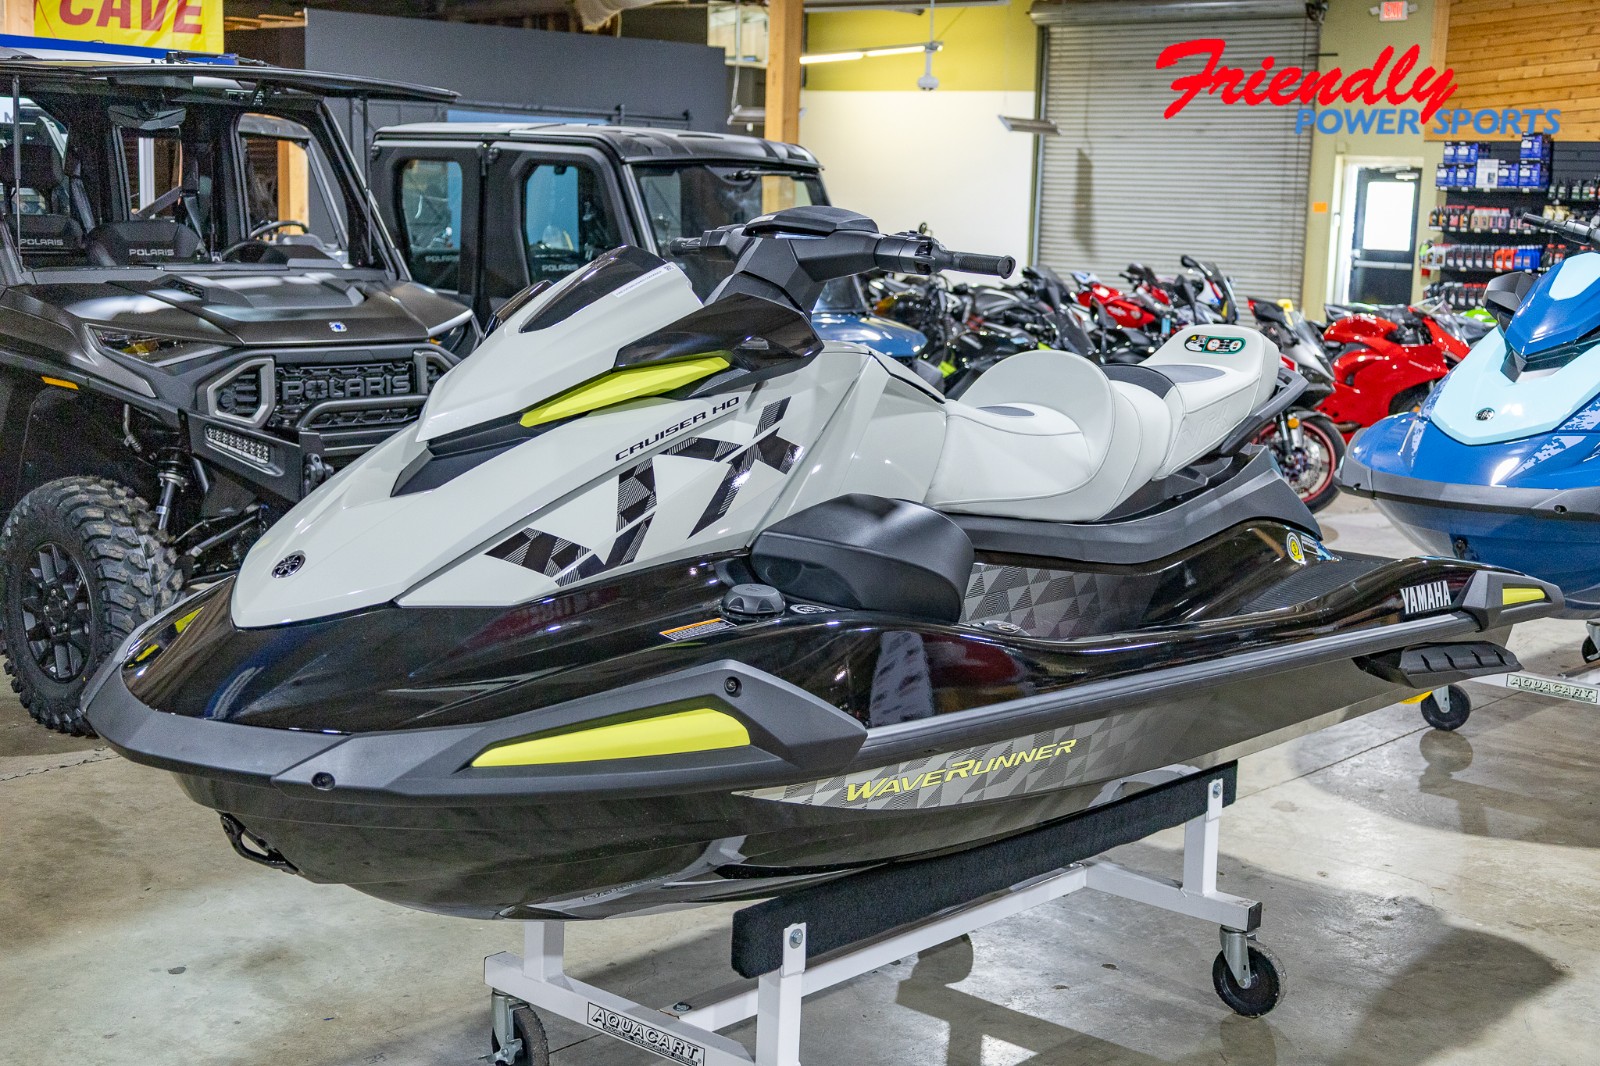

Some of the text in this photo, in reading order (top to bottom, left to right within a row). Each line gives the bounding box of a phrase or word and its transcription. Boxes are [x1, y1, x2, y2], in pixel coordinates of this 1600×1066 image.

[59, 0, 203, 35] CAVE
[19, 237, 64, 247] POLARIS
[129, 248, 175, 257] POLARIS
[282, 374, 411, 400] POLARIS
[615, 411, 707, 461] CRUISER
[1400, 580, 1452, 615] YAMAHA
[592, 1009, 699, 1059] AQUACART
